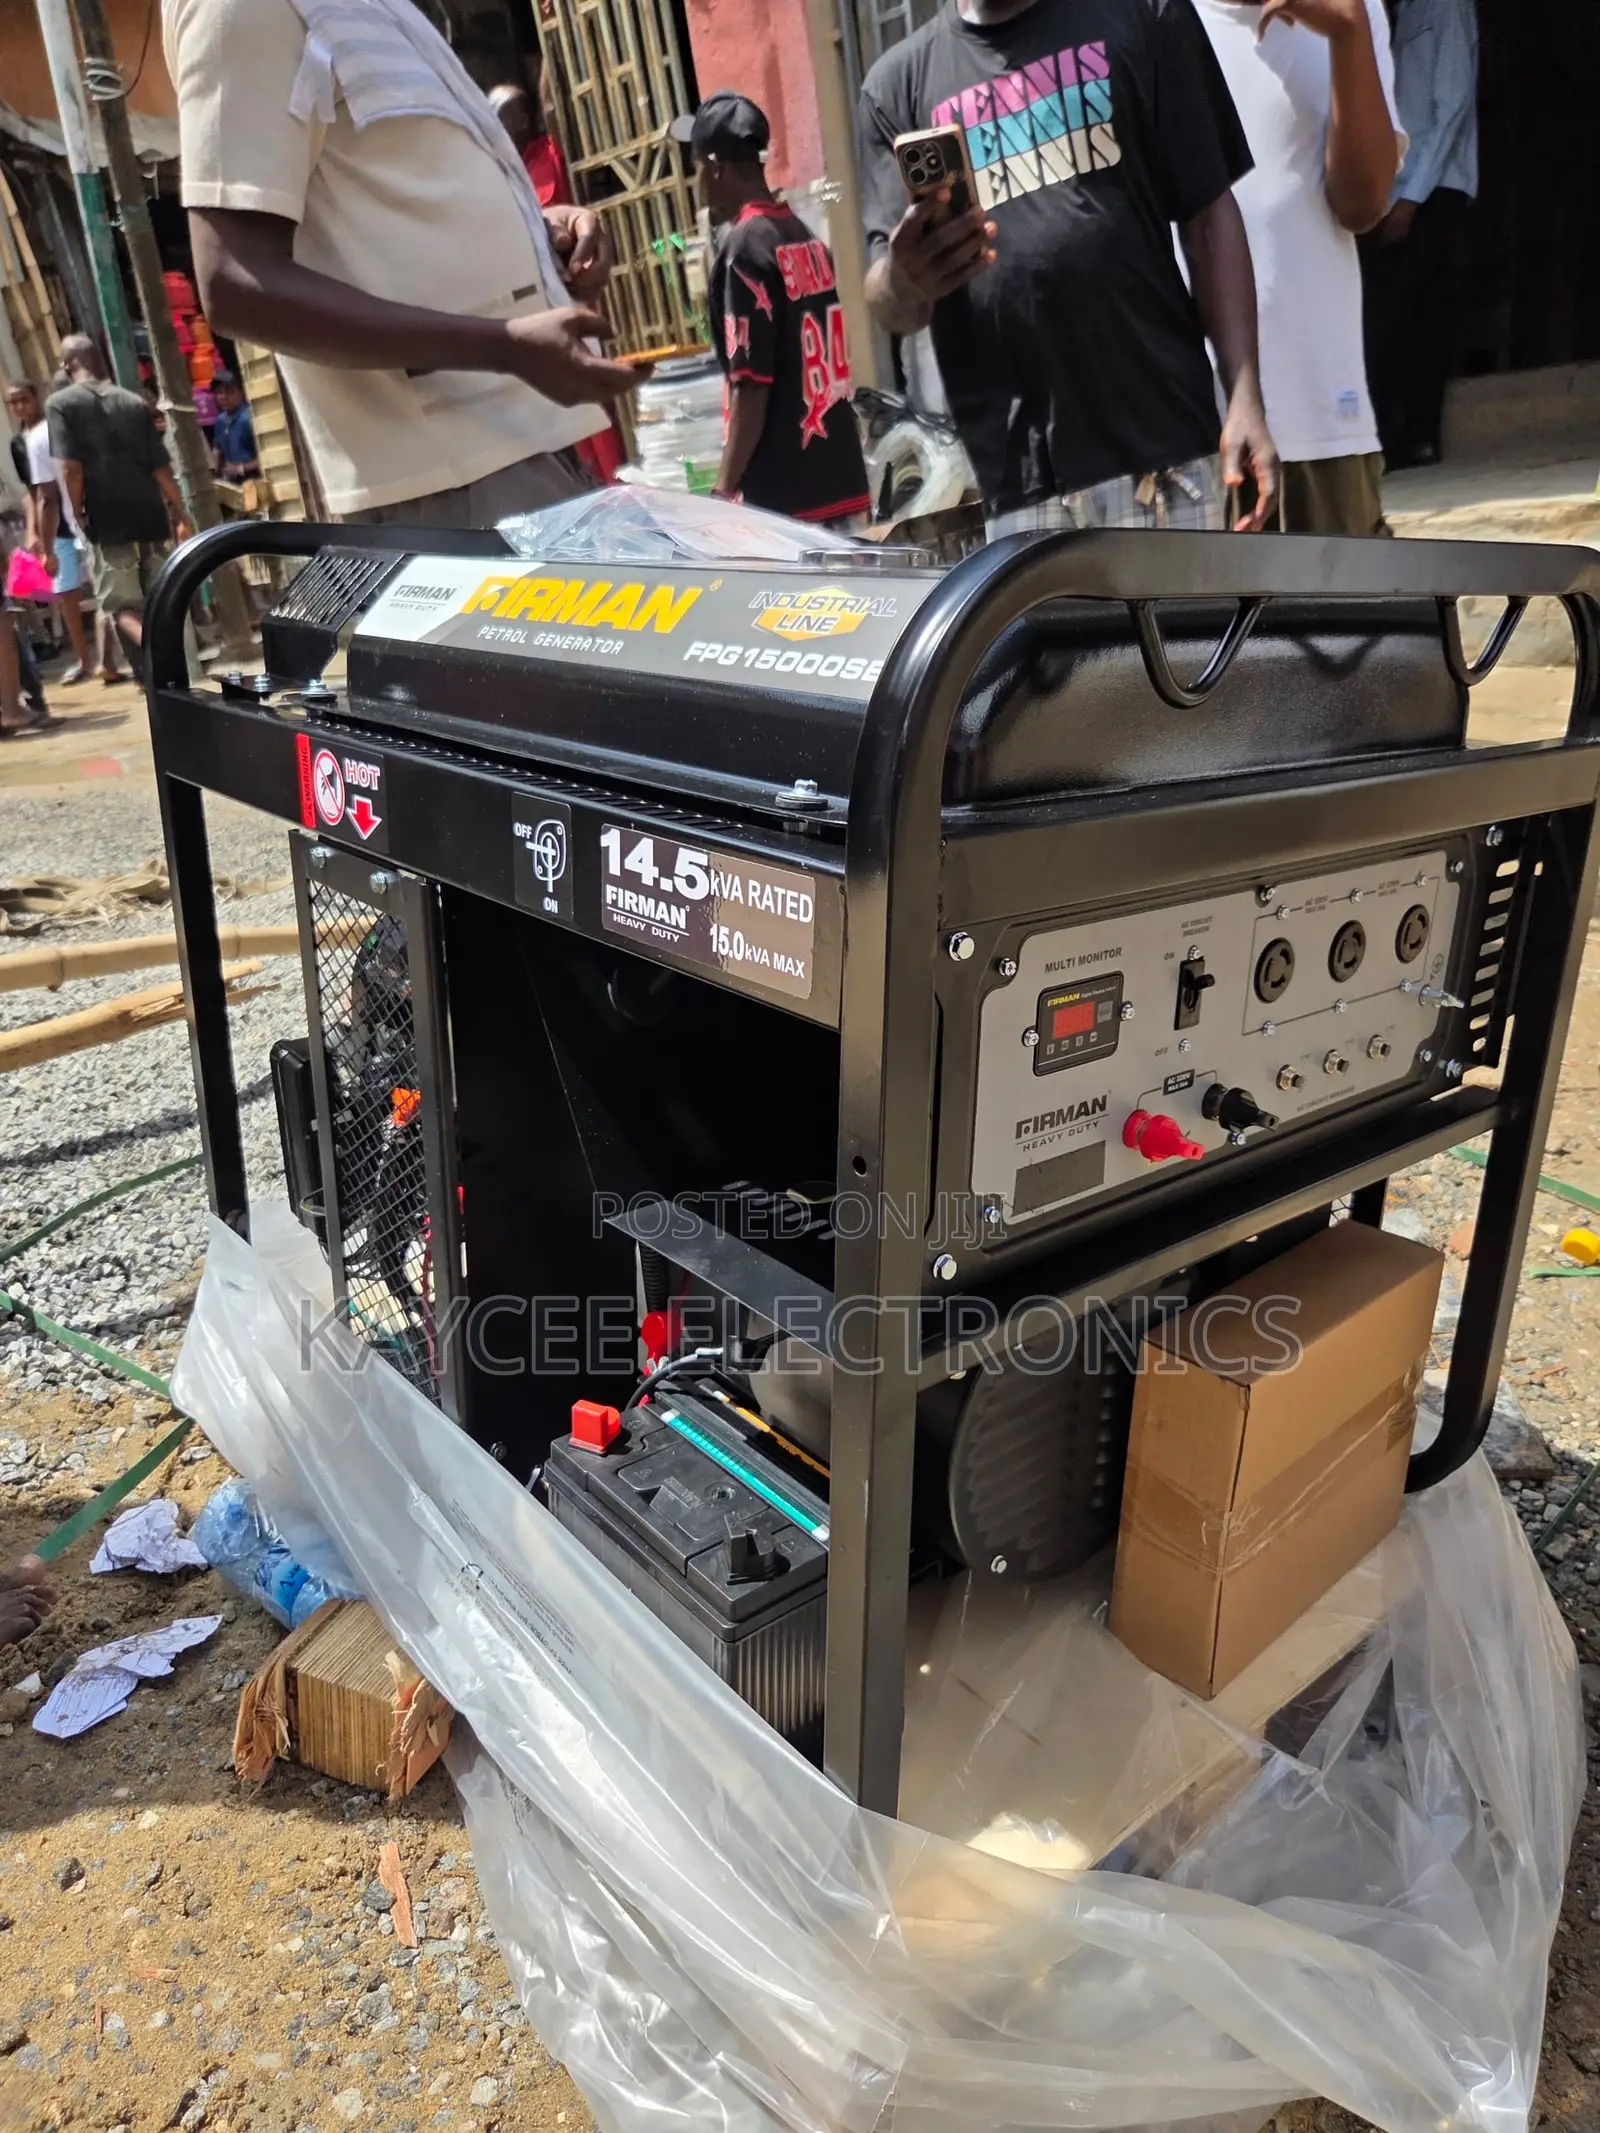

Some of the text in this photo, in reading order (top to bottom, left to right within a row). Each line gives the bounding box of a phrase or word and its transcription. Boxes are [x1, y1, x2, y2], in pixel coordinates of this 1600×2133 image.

[965, 79, 1113, 170] ENNIS
[974, 122, 1121, 212] ENNIS
[393, 584, 457, 601] FIRMAN
[461, 576, 702, 634] FIRMAN
[748, 591, 898, 618] INDUSTRIAL
[776, 612, 836, 634] LINE
[477, 623, 625, 655] PETROL GENERATOR
[342, 756, 382, 791] HOT
[513, 821, 533, 839] OFF
[543, 896, 559, 914] ON
[605, 884, 686, 930] FIRMAN
[748, 879, 814, 924] RATED
[613, 913, 680, 943] HEAVY DUTY
[772, 952, 806, 980] MAX
[1044, 946, 1122, 973] MULTI MONITOR
[1155, 1047, 1168, 1057] OFF
[1014, 1094, 1107, 1140] FIRMAN
[1022, 1120, 1100, 1152] HEAVY DUTY
